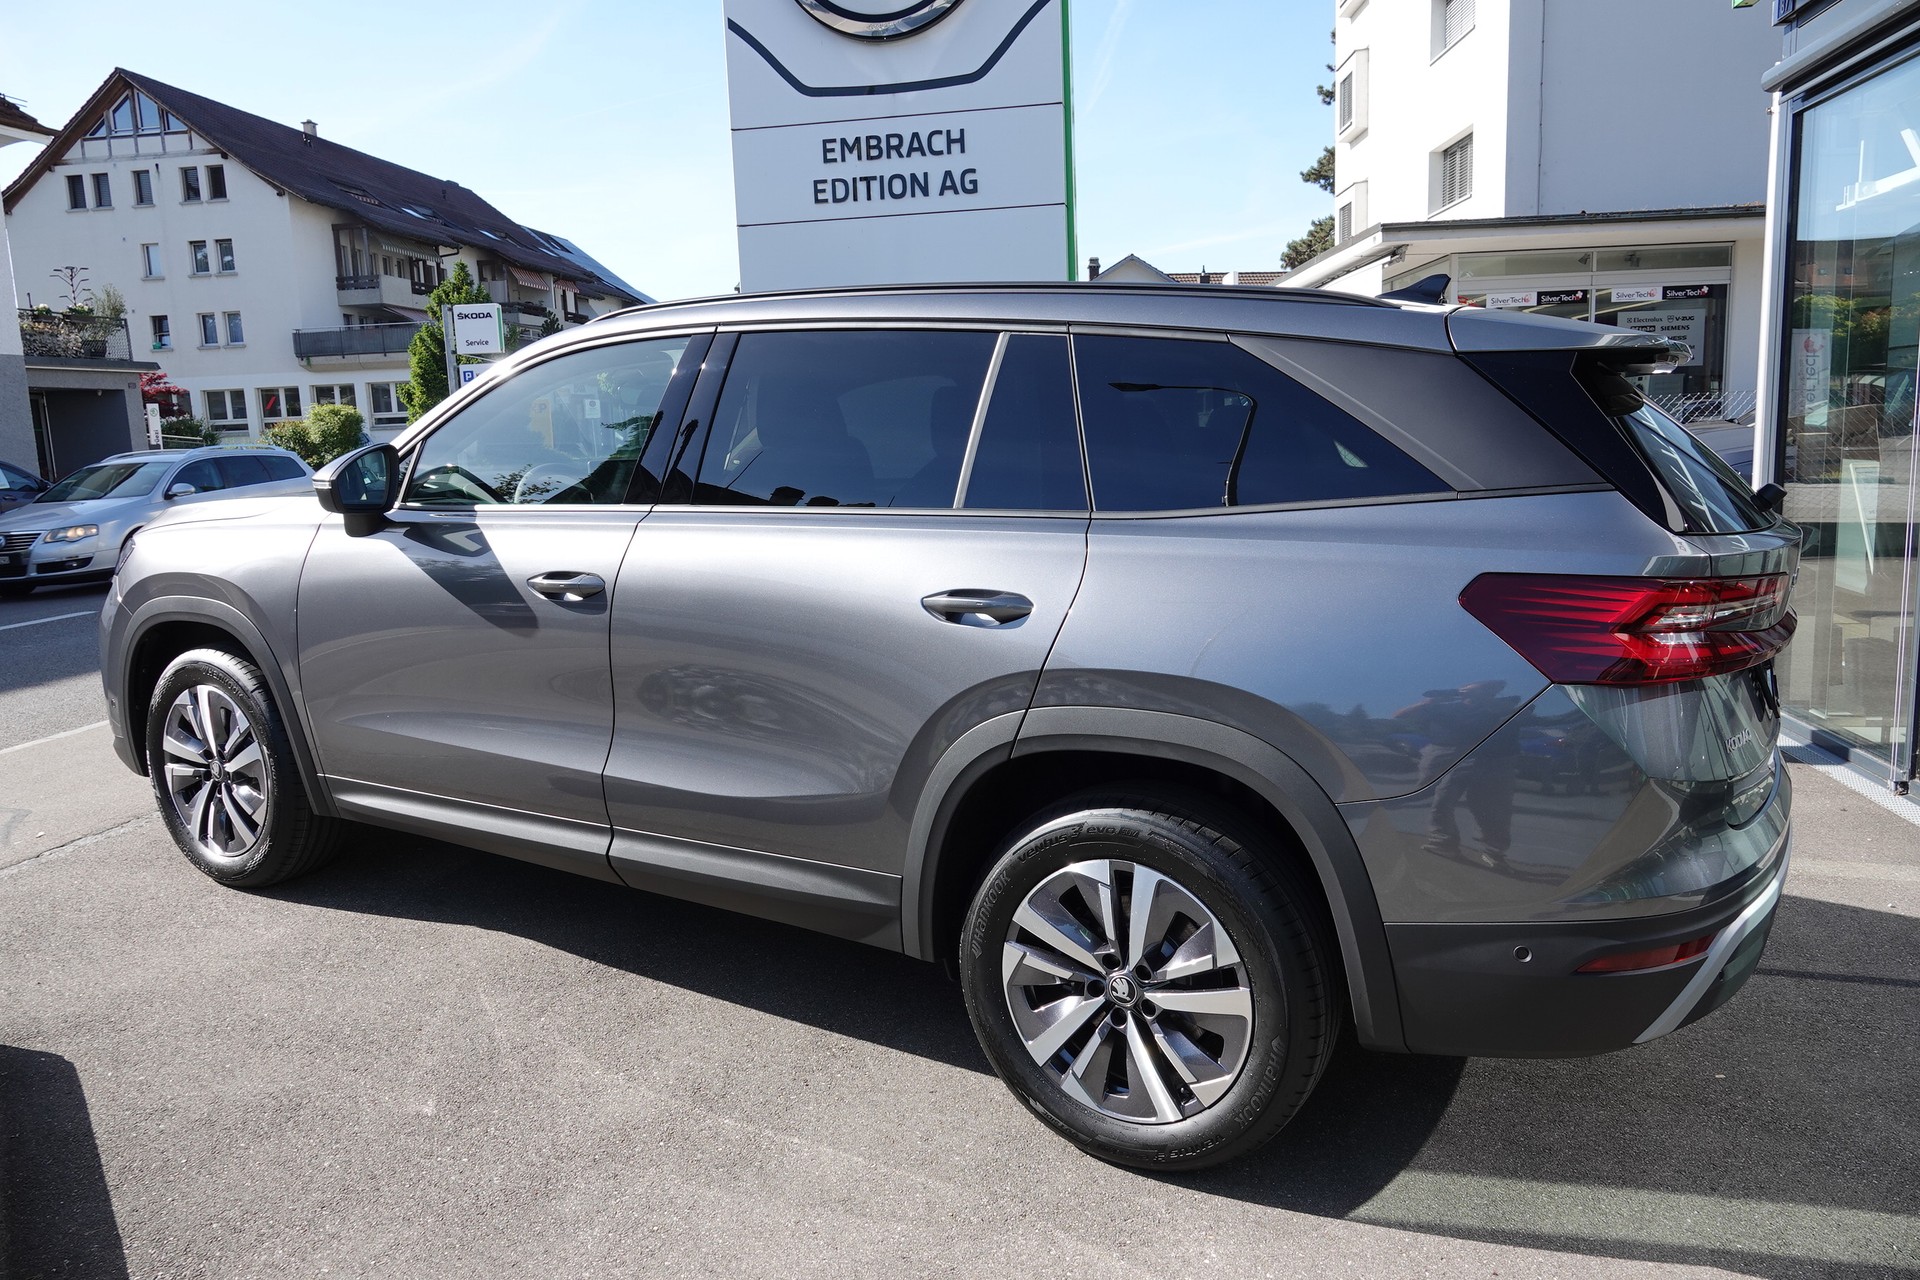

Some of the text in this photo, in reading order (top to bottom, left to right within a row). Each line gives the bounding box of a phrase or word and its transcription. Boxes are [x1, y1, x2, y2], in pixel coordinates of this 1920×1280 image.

[822, 128, 966, 164] EMBRACH
[813, 168, 979, 204] EDITION AG
